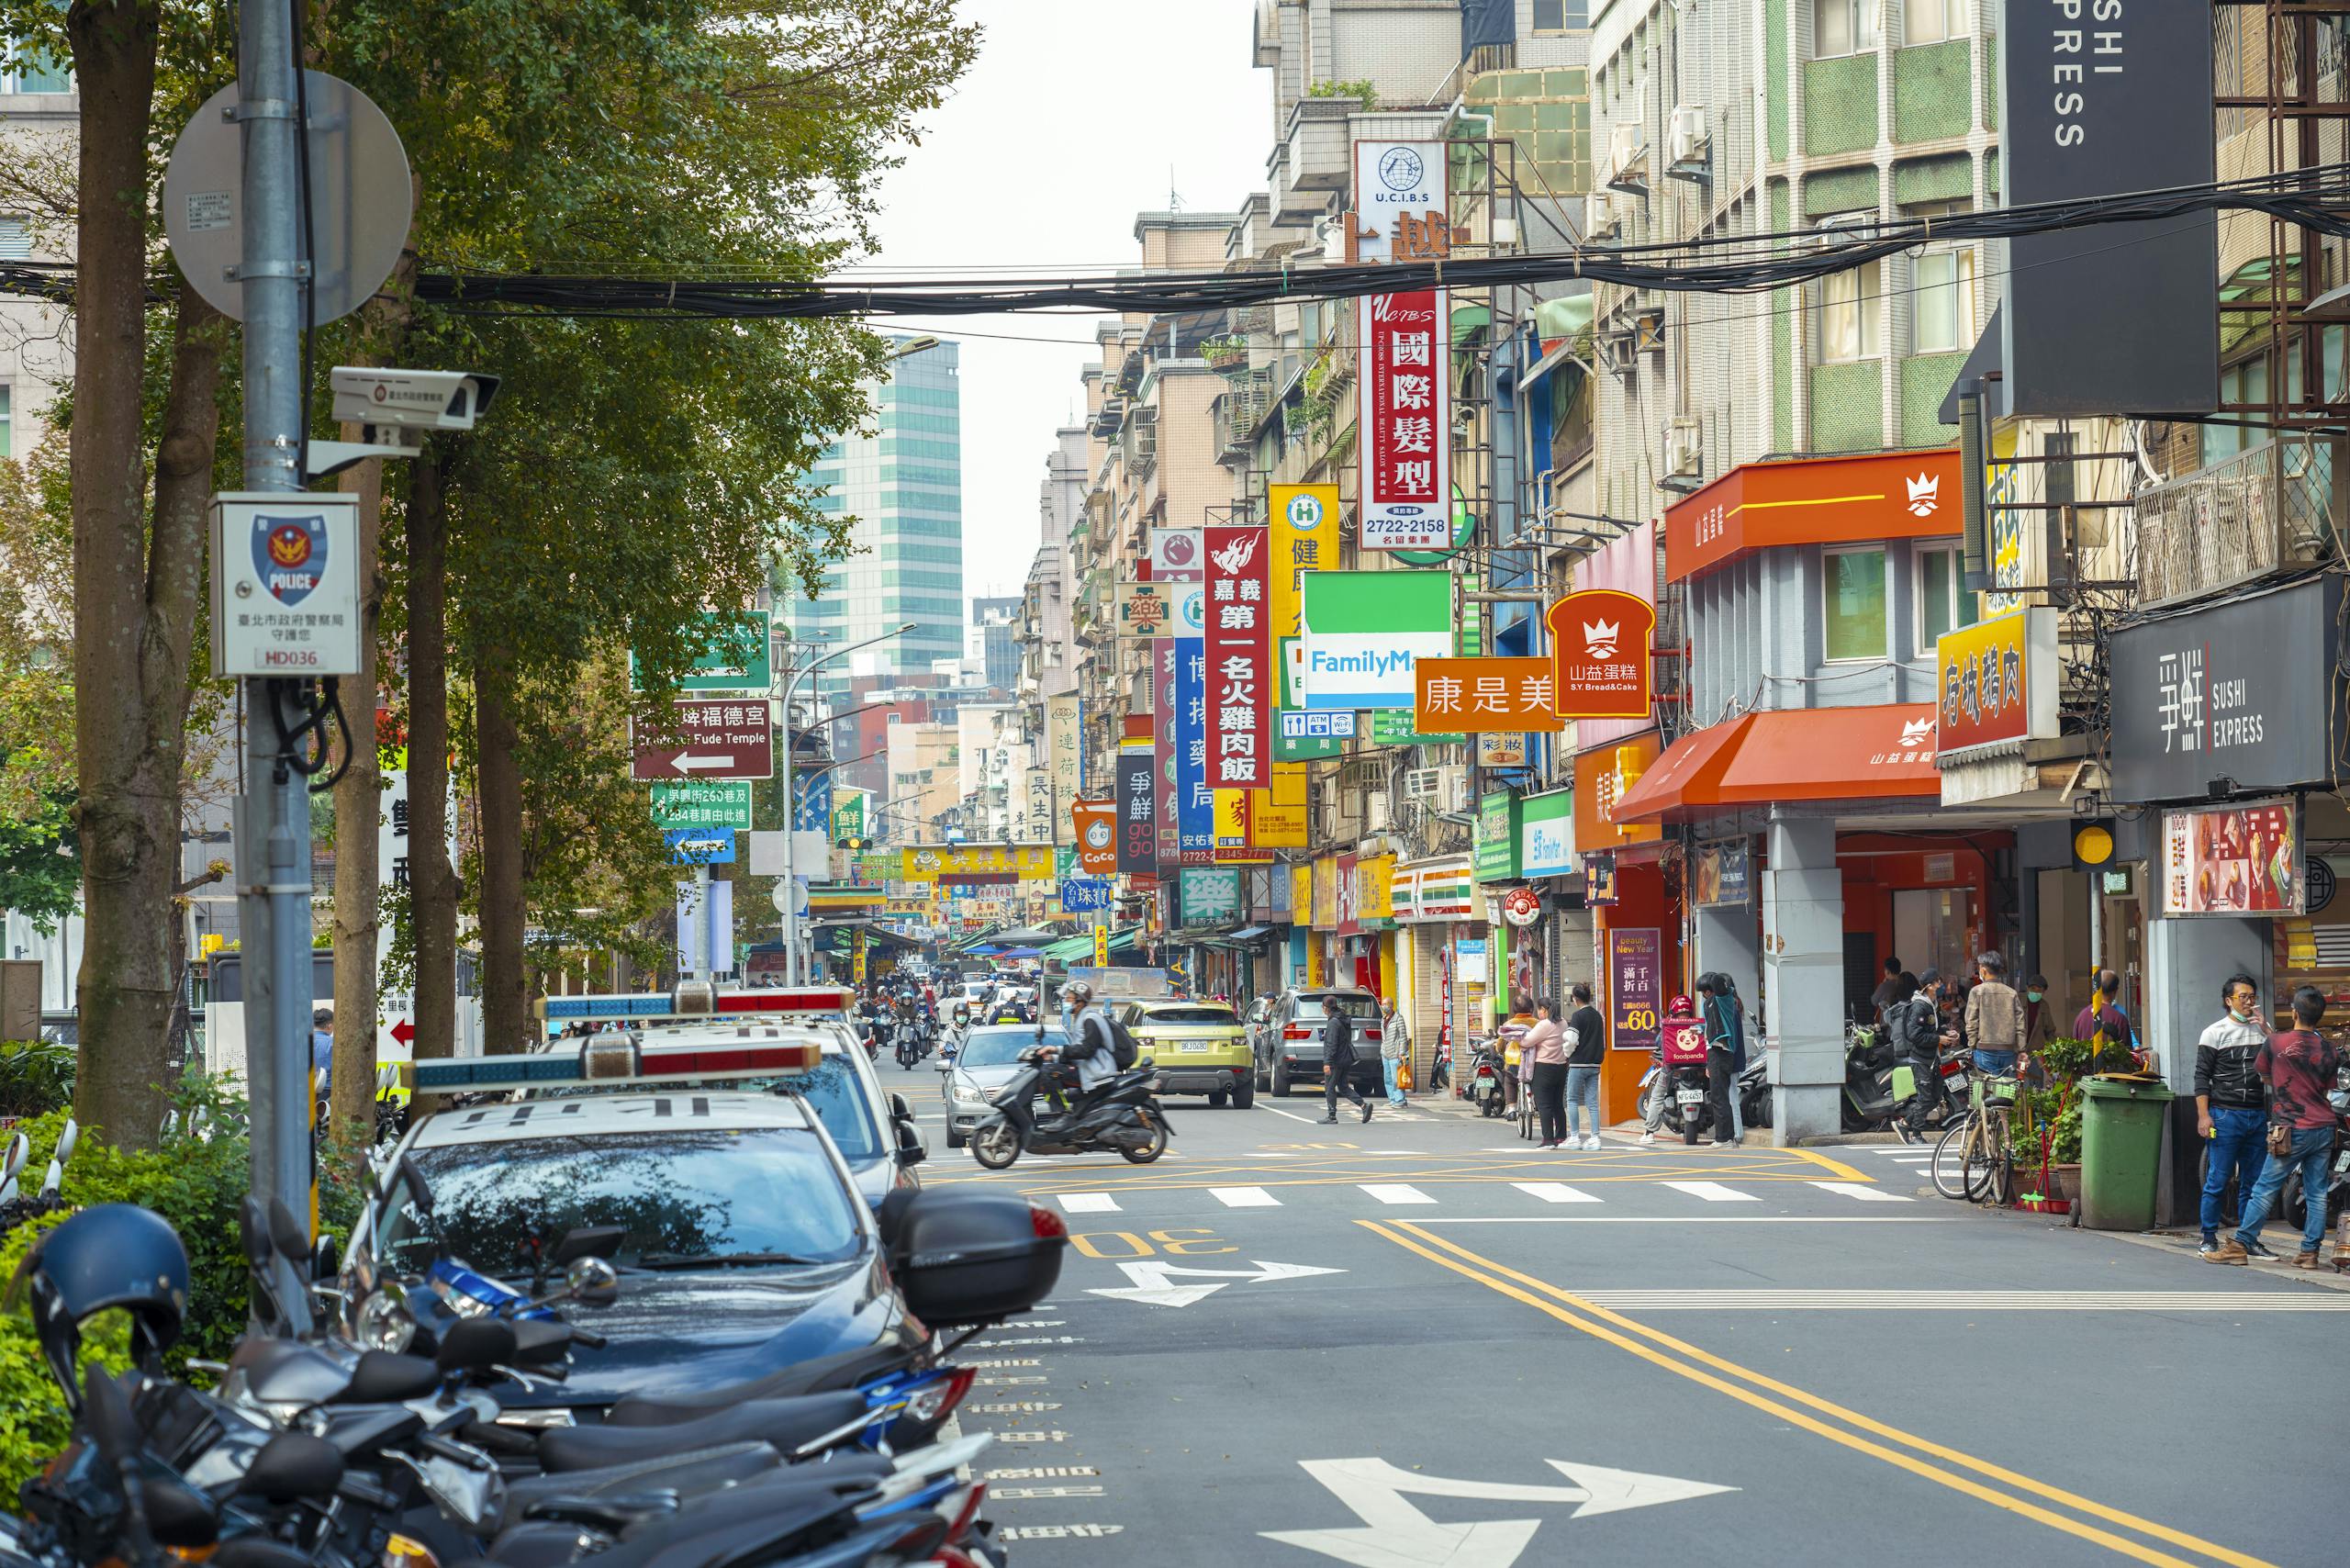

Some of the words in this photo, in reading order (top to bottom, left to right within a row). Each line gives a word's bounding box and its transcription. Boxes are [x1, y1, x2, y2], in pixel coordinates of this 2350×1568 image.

[1376, 193, 1429, 202] U.C.I.B.S
[1388, 330, 1434, 496] 國際髮型
[1366, 520, 1445, 532] 2722-2158
[1382, 535, 1430, 544] 名留集團
[270, 573, 312, 589] POLICE
[1214, 578, 1261, 602] 嘉義
[1129, 593, 1162, 628] 藥
[238, 613, 344, 627] 臺北市政府警察局
[265, 651, 318, 666] HD036
[1570, 664, 1637, 680] 山益蛋糕
[1571, 683, 1584, 691] S.Y.
[1585, 683, 1638, 691] Bread&Cake
[1942, 642, 2020, 727] 府城鵝肉
[1218, 605, 1257, 781] 第一名火雞肉飯
[1425, 676, 1551, 714] 康是美
[2212, 678, 2245, 711] SUSHI
[2214, 713, 2264, 748] EXPRESS
[695, 734, 722, 745] Fude
[724, 733, 766, 746] Temple
[1483, 740, 1523, 751] 彩妝
[1869, 751, 1934, 765] 山益蛋糕
[1130, 770, 1152, 821] 爭鮮
[1128, 823, 1153, 841] go
[951, 847, 1044, 865] 吳興商圈
[1128, 841, 1153, 857] go
[1084, 853, 1115, 864] CoCo
[1185, 869, 1237, 916] 藥
[1617, 945, 1635, 954] New
